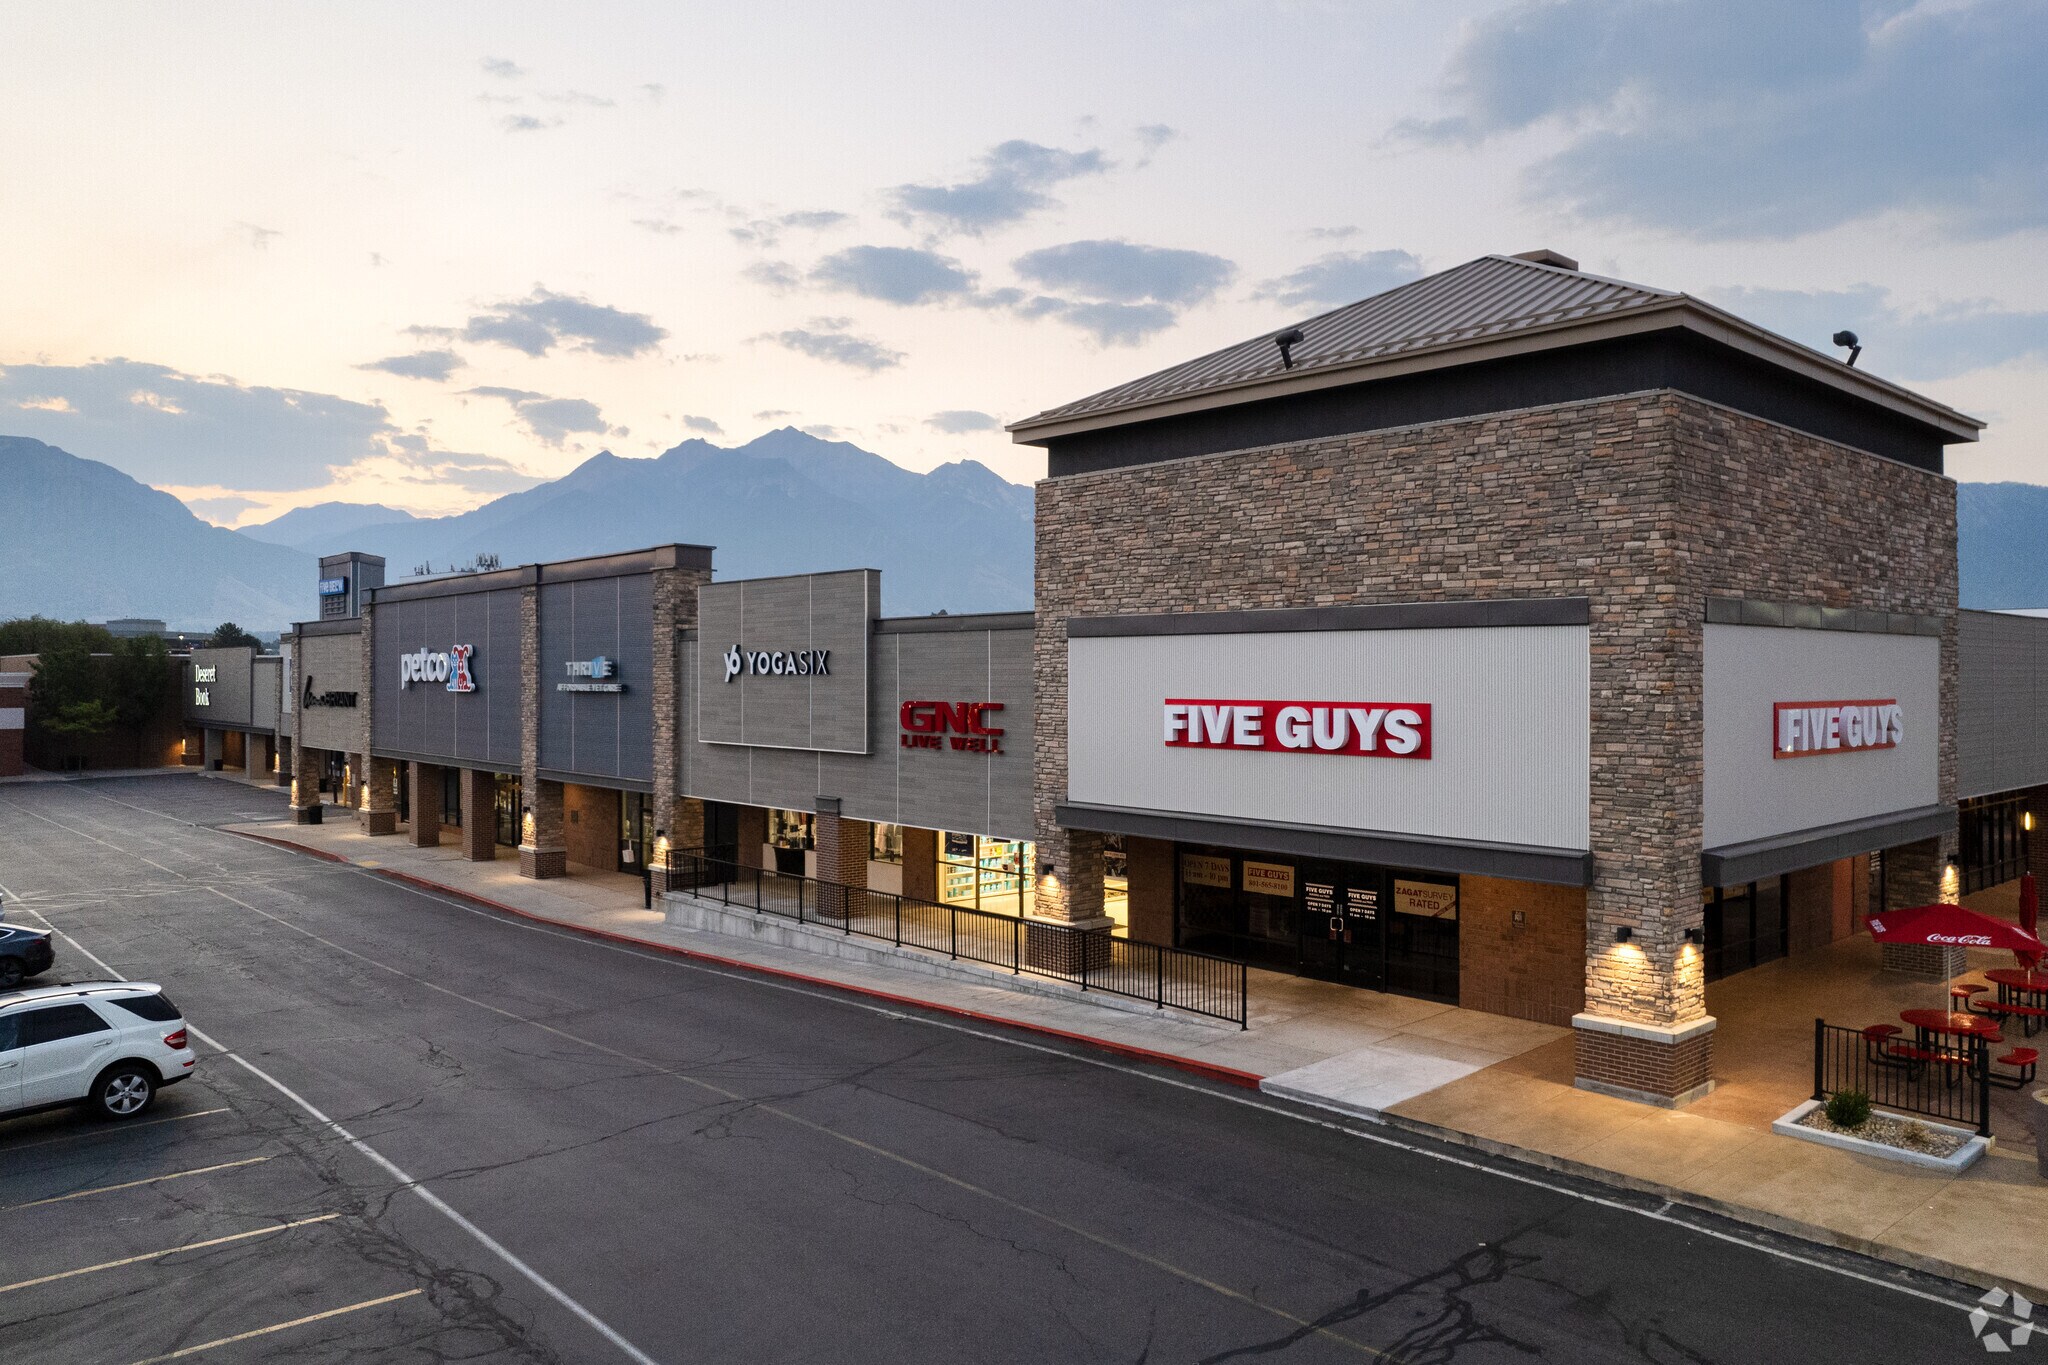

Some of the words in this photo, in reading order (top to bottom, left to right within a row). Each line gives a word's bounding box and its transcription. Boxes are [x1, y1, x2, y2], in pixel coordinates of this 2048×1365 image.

[401, 647, 450, 690] petco
[565, 661, 612, 676] THRIVE
[747, 650, 830, 675] YOGASIX
[195, 664, 216, 682] Deseret
[195, 687, 210, 705] Book
[900, 700, 1004, 735] GNC
[1164, 704, 1265, 746] FIVE
[1275, 706, 1423, 754] GUYS
[1778, 707, 1840, 752] FIVE
[1840, 704, 1903, 748] GUYS
[901, 734, 942, 750] LIVE
[949, 736, 1005, 754] WELL
[1211, 862, 1229, 872] DAYS
[1248, 868, 1266, 877] FIVE
[1267, 870, 1289, 880] GUYS
[1409, 898, 1440, 910] RATED
[1926, 933, 1992, 946] Coca-Cola
